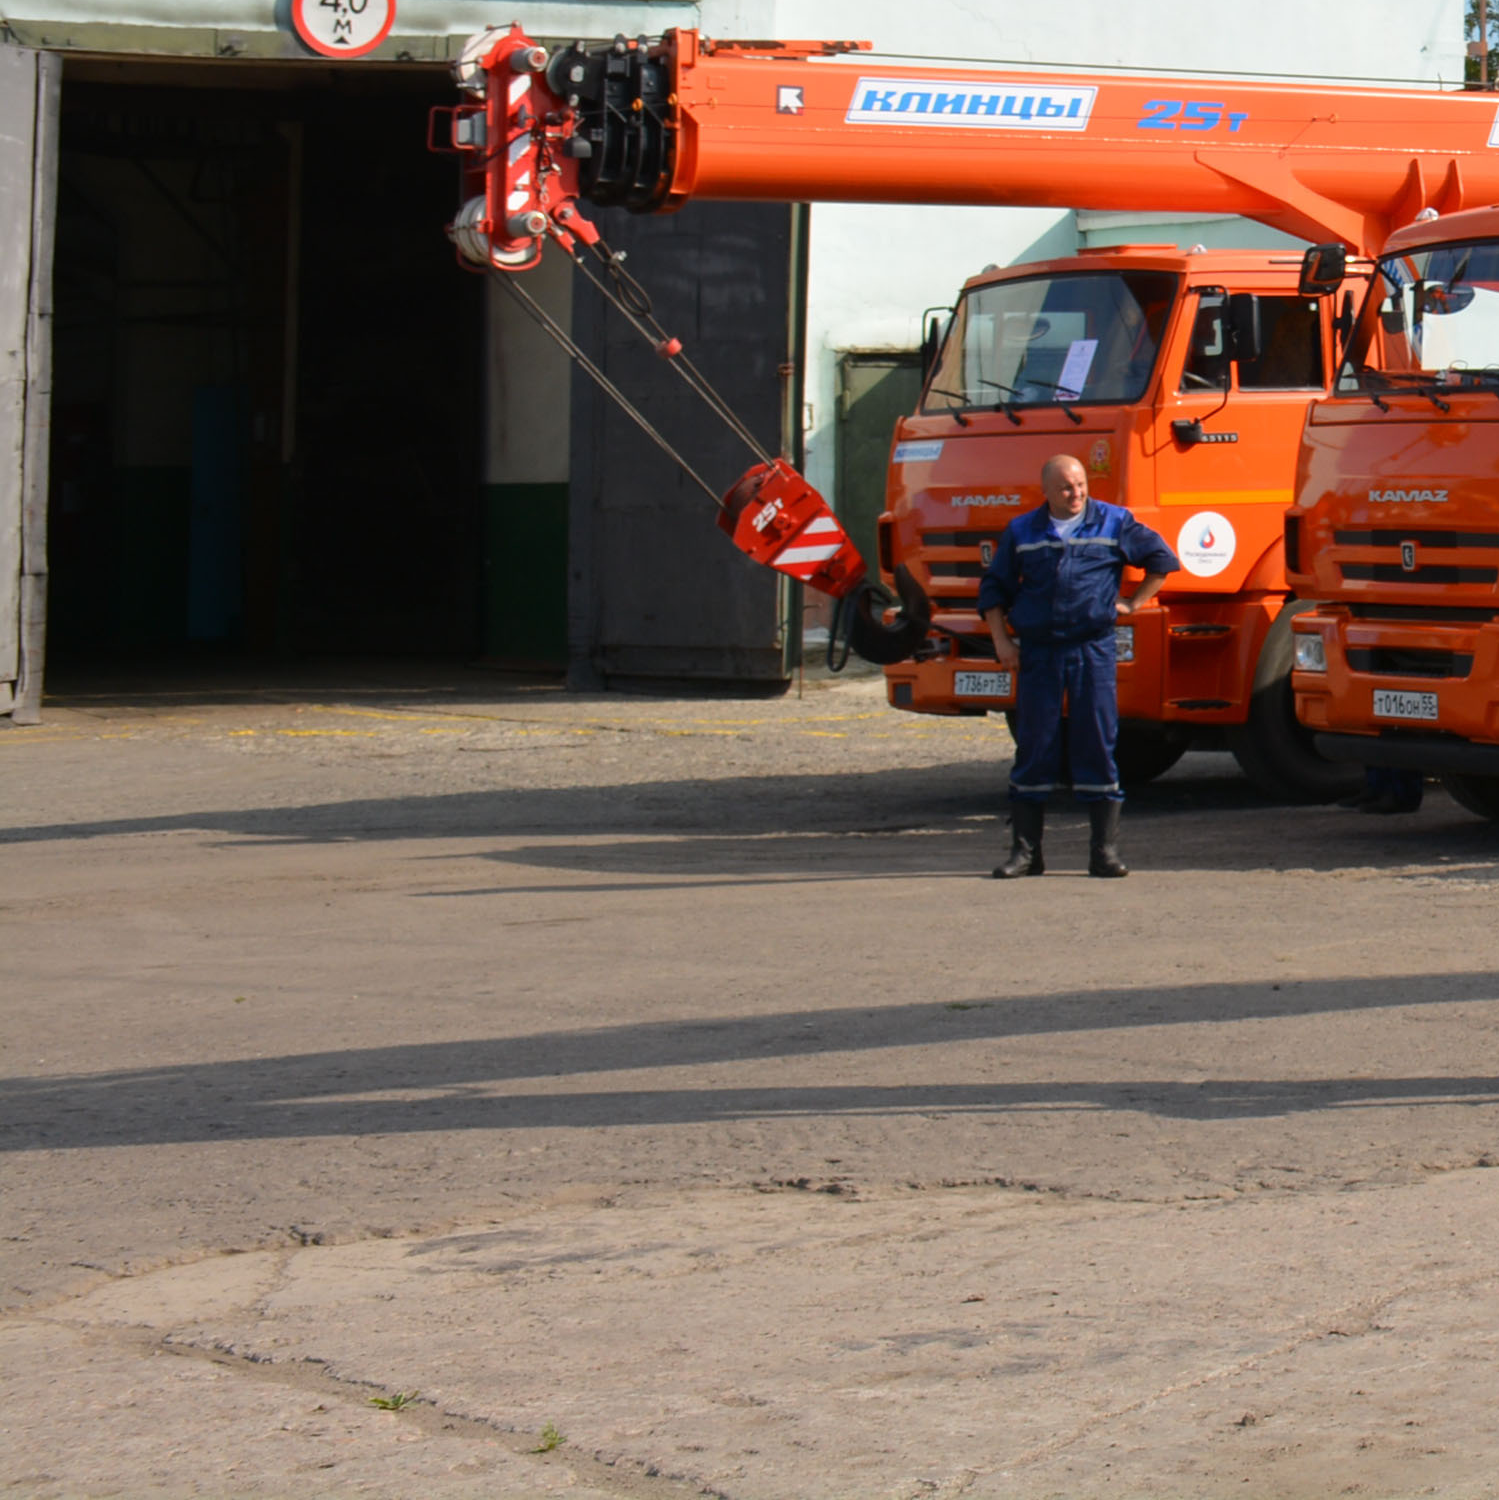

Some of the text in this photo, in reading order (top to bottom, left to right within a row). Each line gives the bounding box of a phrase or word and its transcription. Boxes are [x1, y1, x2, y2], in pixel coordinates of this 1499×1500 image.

[860, 90, 1083, 120] КЛИНЦЫ
[951, 494, 1021, 507] KAMAZ
[1368, 489, 1449, 503] KAMAZ
